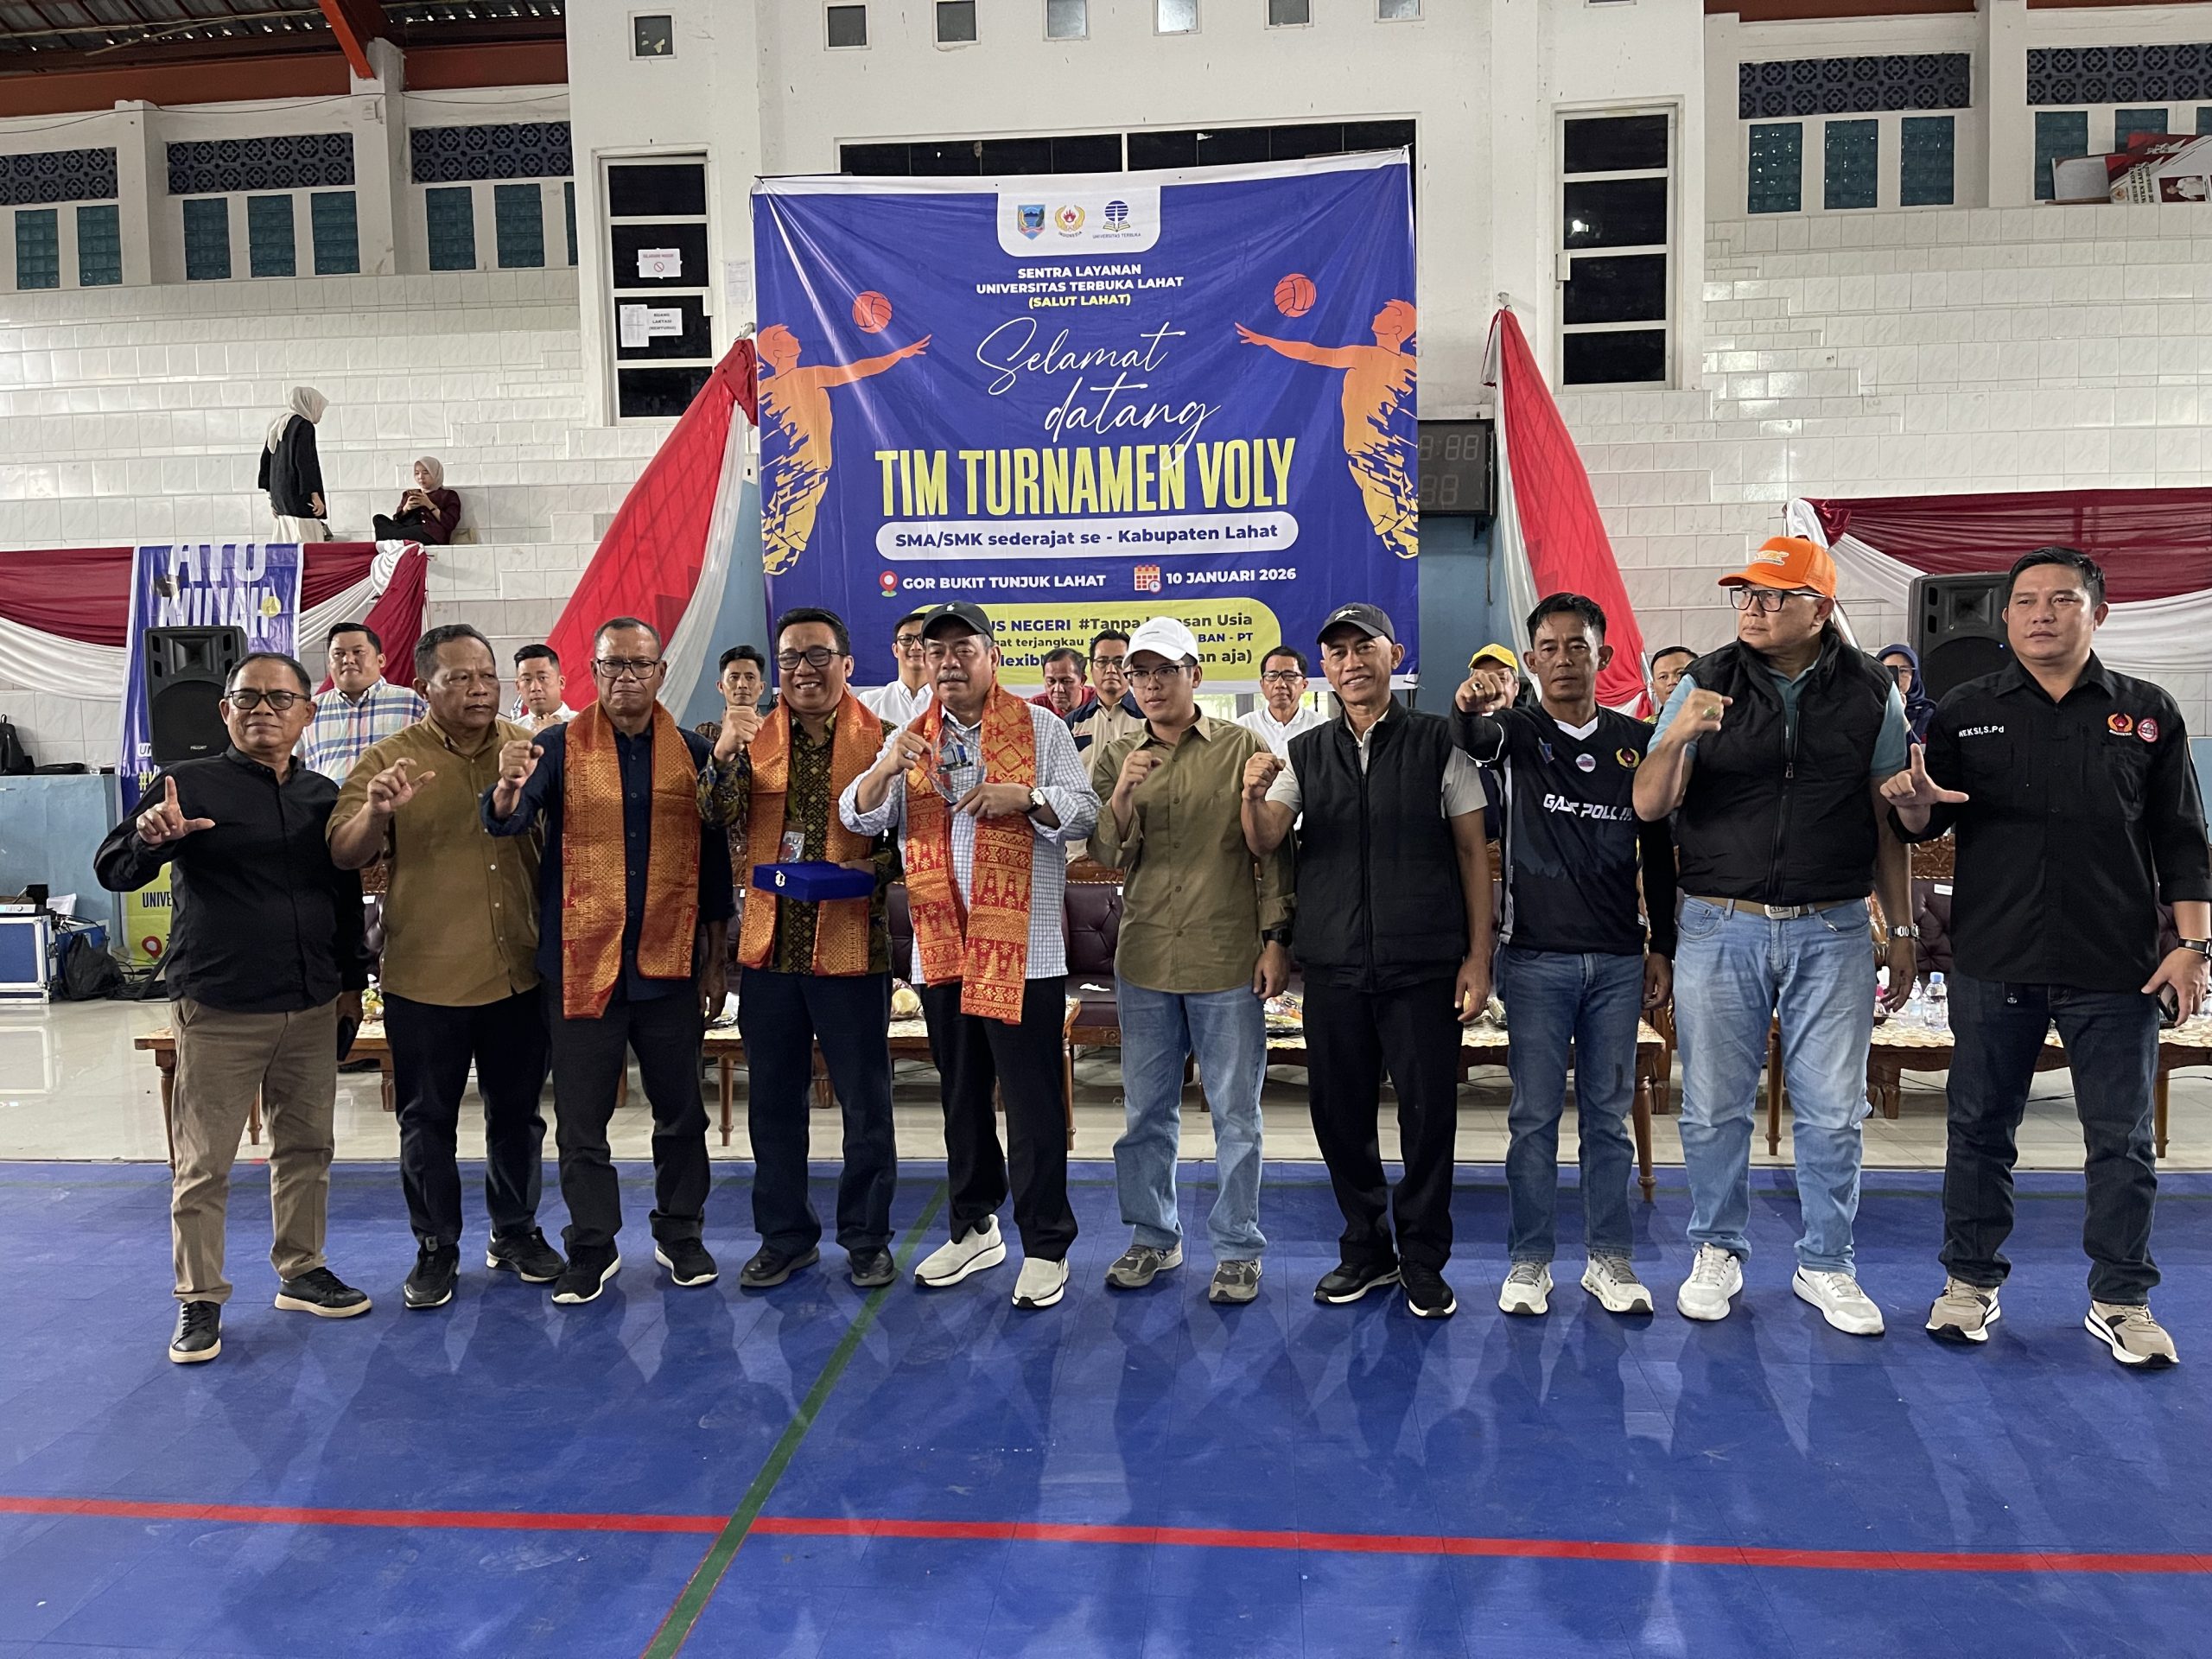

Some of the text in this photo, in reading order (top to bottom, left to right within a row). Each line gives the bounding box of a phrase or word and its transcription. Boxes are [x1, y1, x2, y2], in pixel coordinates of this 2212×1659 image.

[1017, 264, 1141, 279] SENTRA LAYANAN
[976, 276, 1185, 295] UNIVERSITAS TERBUKA LAHAT
[1028, 293, 1131, 309] (SALUT LAHAT)
[976, 316, 1186, 395] Selamat
[1044, 372, 1222, 471] datang
[874, 437, 1296, 517] TIM TURNAMEN VOLY
[894, 531, 983, 548] SMA/SMK
[988, 530, 1076, 549] sederajat
[1079, 533, 1101, 545] se
[1118, 528, 1219, 544] Kabupaten
[1225, 524, 1278, 539] Lahat
[902, 575, 1106, 589] GOR BUKIT TUNJUK LAHAT
[1166, 568, 1297, 585] 10 JANUARI 2026
[1011, 620, 1071, 632] NEGERI
[1078, 616, 1141, 633] #Tanpa
[1217, 612, 1253, 626] Usia
[1017, 637, 1085, 649] terjangkau
[1198, 633, 1225, 643] BAN
[1237, 632, 1254, 642] PT
[1221, 648, 1253, 665] aja)
